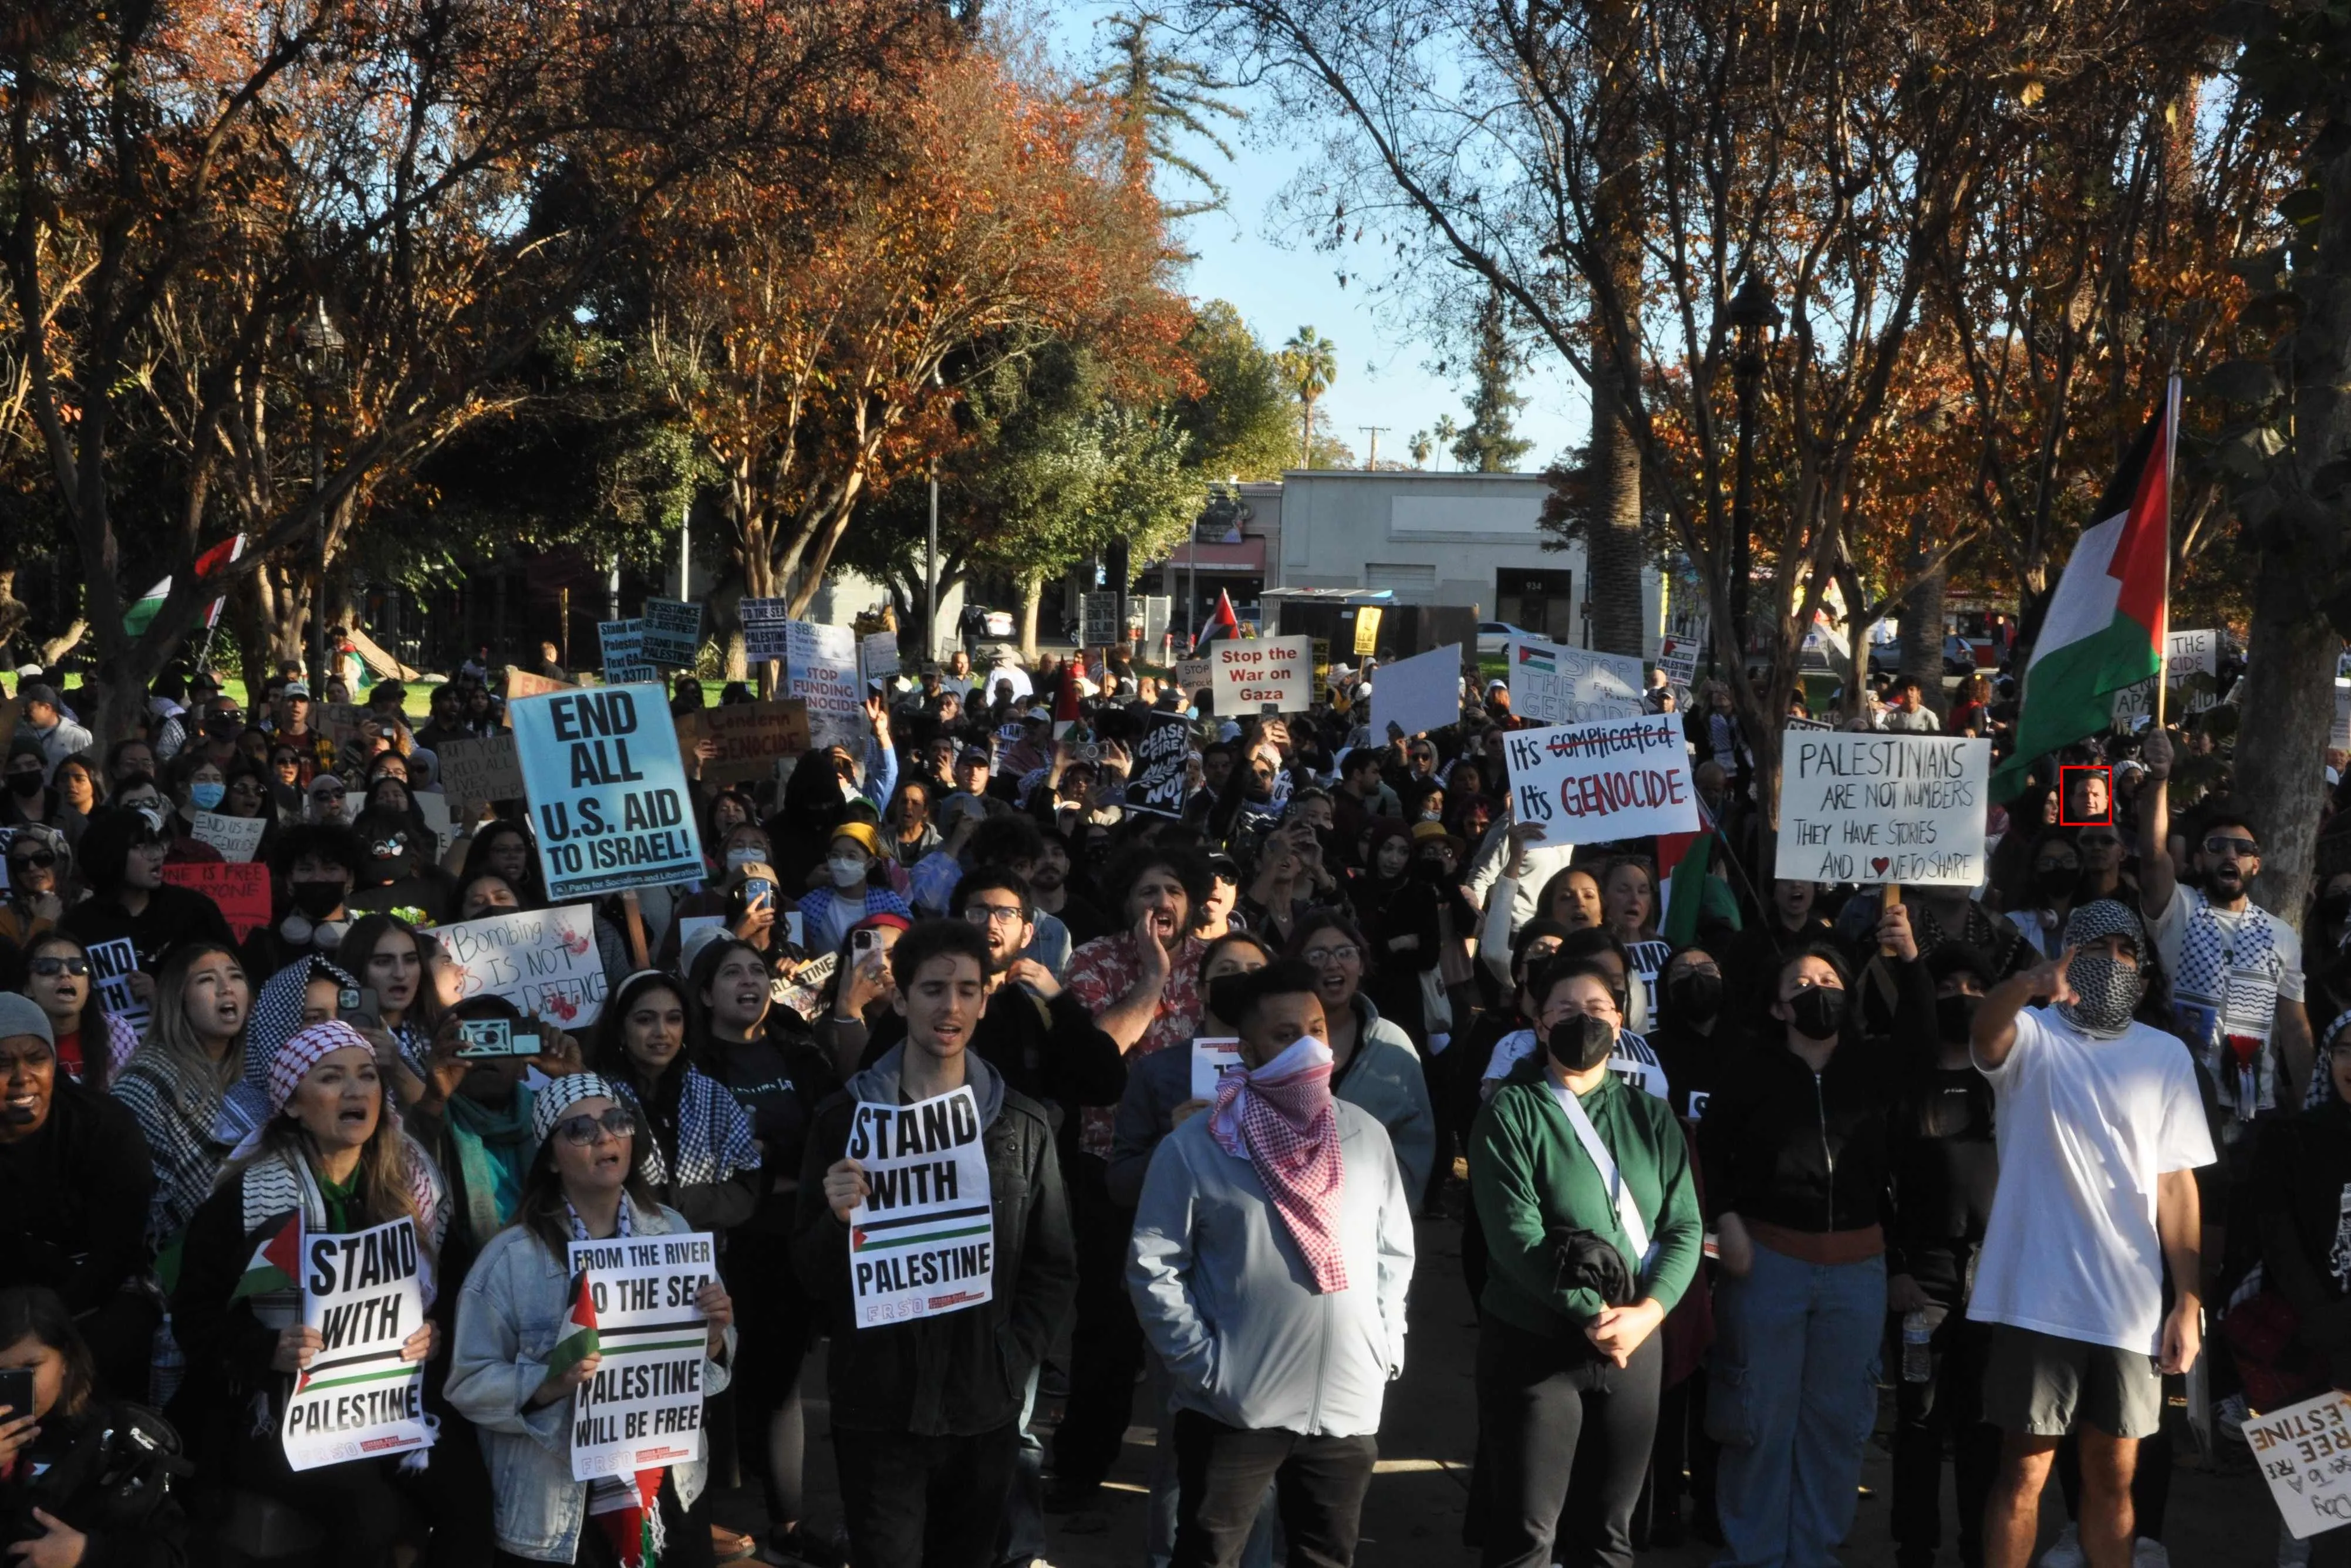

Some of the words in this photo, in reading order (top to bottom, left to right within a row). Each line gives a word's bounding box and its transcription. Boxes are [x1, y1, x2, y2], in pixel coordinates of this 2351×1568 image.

[743, 609, 752, 619] TO
[754, 608, 768, 618] THE
[770, 607, 785, 618] SEA
[601, 622, 627, 635] Stand
[628, 621, 643, 632] wit
[643, 636, 671, 649] STAND
[604, 638, 642, 652] Palestin
[642, 647, 693, 663] PALESTINE
[1222, 649, 1263, 665] Stop
[1269, 647, 1297, 660] the
[2171, 635, 2205, 654] THE
[606, 656, 625, 668] Text
[626, 653, 639, 667] GA
[807, 666, 838, 682] STOP
[1185, 665, 1209, 675] STOP
[1229, 669, 1264, 682] War
[1270, 668, 1291, 680] on
[1564, 652, 1633, 684] STOP
[1657, 658, 1694, 672] PALESTINE
[2170, 656, 2204, 671] CIDE
[609, 673, 620, 684] to
[792, 680, 854, 698] FUNDING
[1181, 679, 1212, 688] Genocid
[1520, 669, 1576, 698] THE
[1240, 688, 1283, 701] Gaza
[548, 690, 638, 742] END
[707, 706, 791, 731] Condemn
[475, 737, 512, 756] YOU
[710, 733, 800, 761] GENOCIDE
[1139, 723, 1185, 758] CEASE
[1510, 737, 1542, 771] It's
[485, 756, 512, 771] ALL
[571, 737, 643, 788] ALL
[1800, 741, 1966, 779] PALESTINIANS
[1521, 784, 1552, 820] It's
[1561, 768, 1688, 818] GENOCIDE.
[1820, 783, 1857, 811] ARE
[1866, 781, 1899, 810] NOT
[1904, 781, 1974, 810] NUMBERS
[195, 814, 225, 833] END
[229, 821, 242, 834] US
[540, 797, 616, 842] U.S.
[624, 788, 682, 832] AID
[1793, 819, 1832, 846] THEY
[1843, 820, 1880, 845] HAVE
[1886, 819, 1937, 847] STORIES
[546, 844, 583, 875] TO
[588, 829, 692, 869] ISRAEL!
[1819, 851, 1853, 879] AND
[1909, 854, 1925, 880] TO
[1925, 851, 1972, 879] SHARE
[203, 866, 216, 881] IS
[225, 864, 261, 881] FREE
[569, 882, 590, 893] Party
[592, 879, 603, 888] for
[605, 875, 643, 886] Socialism
[645, 873, 659, 881] and
[660, 868, 703, 880] Liberation
[195, 883, 259, 898] RYONE
[453, 919, 542, 963] Bombing
[486, 956, 521, 987] IS
[526, 943, 573, 977] NOT
[1627, 943, 1671, 973] AND
[522, 972, 609, 1014] DEFENCE
[851, 1093, 977, 1160] STAND
[864, 1161, 959, 1212] WITH
[310, 1222, 417, 1297] STAND
[573, 1247, 624, 1271] FROM
[628, 1244, 660, 1266] THE
[665, 1241, 710, 1264] RIVER
[856, 1242, 991, 1296] PALESTINE
[616, 1278, 659, 1311] THE
[321, 1293, 402, 1353] WITH
[867, 1298, 924, 1322] FRSO
[580, 1360, 701, 1408] PALESTINE
[289, 1384, 420, 1438] PALESTINE
[576, 1415, 618, 1448] WILL
[625, 1410, 647, 1438] BE
[655, 1405, 699, 1435] FREE
[2249, 1403, 2345, 1451] ESTINE
[2297, 1427, 2351, 1464] REE
